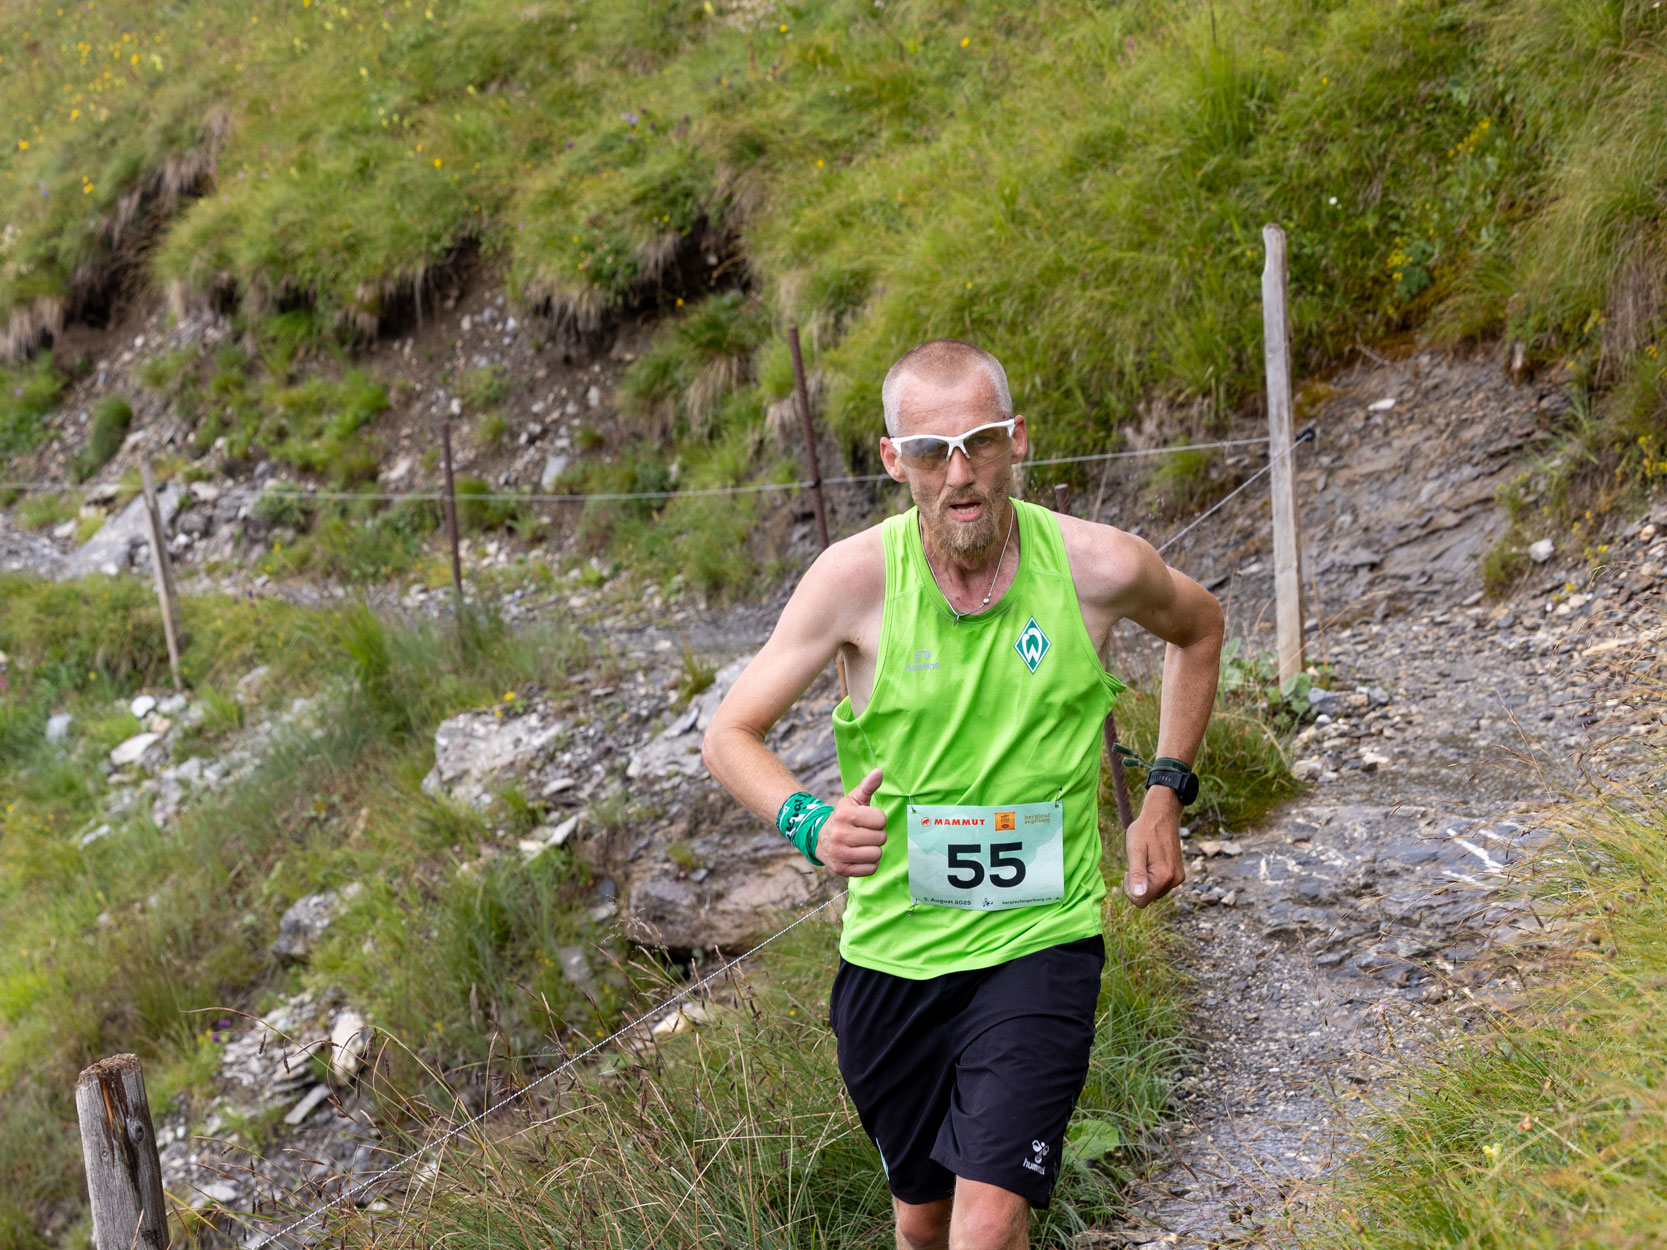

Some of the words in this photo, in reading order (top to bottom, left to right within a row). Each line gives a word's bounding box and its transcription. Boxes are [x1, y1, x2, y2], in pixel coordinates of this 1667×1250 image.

[1024, 812, 1051, 820] berglauf
[934, 818, 986, 826] MAMMUT
[1024, 817, 1051, 825] engelberg
[947, 841, 1026, 889] 55
[1002, 897, 1051, 905] berglaufengelberg.ch
